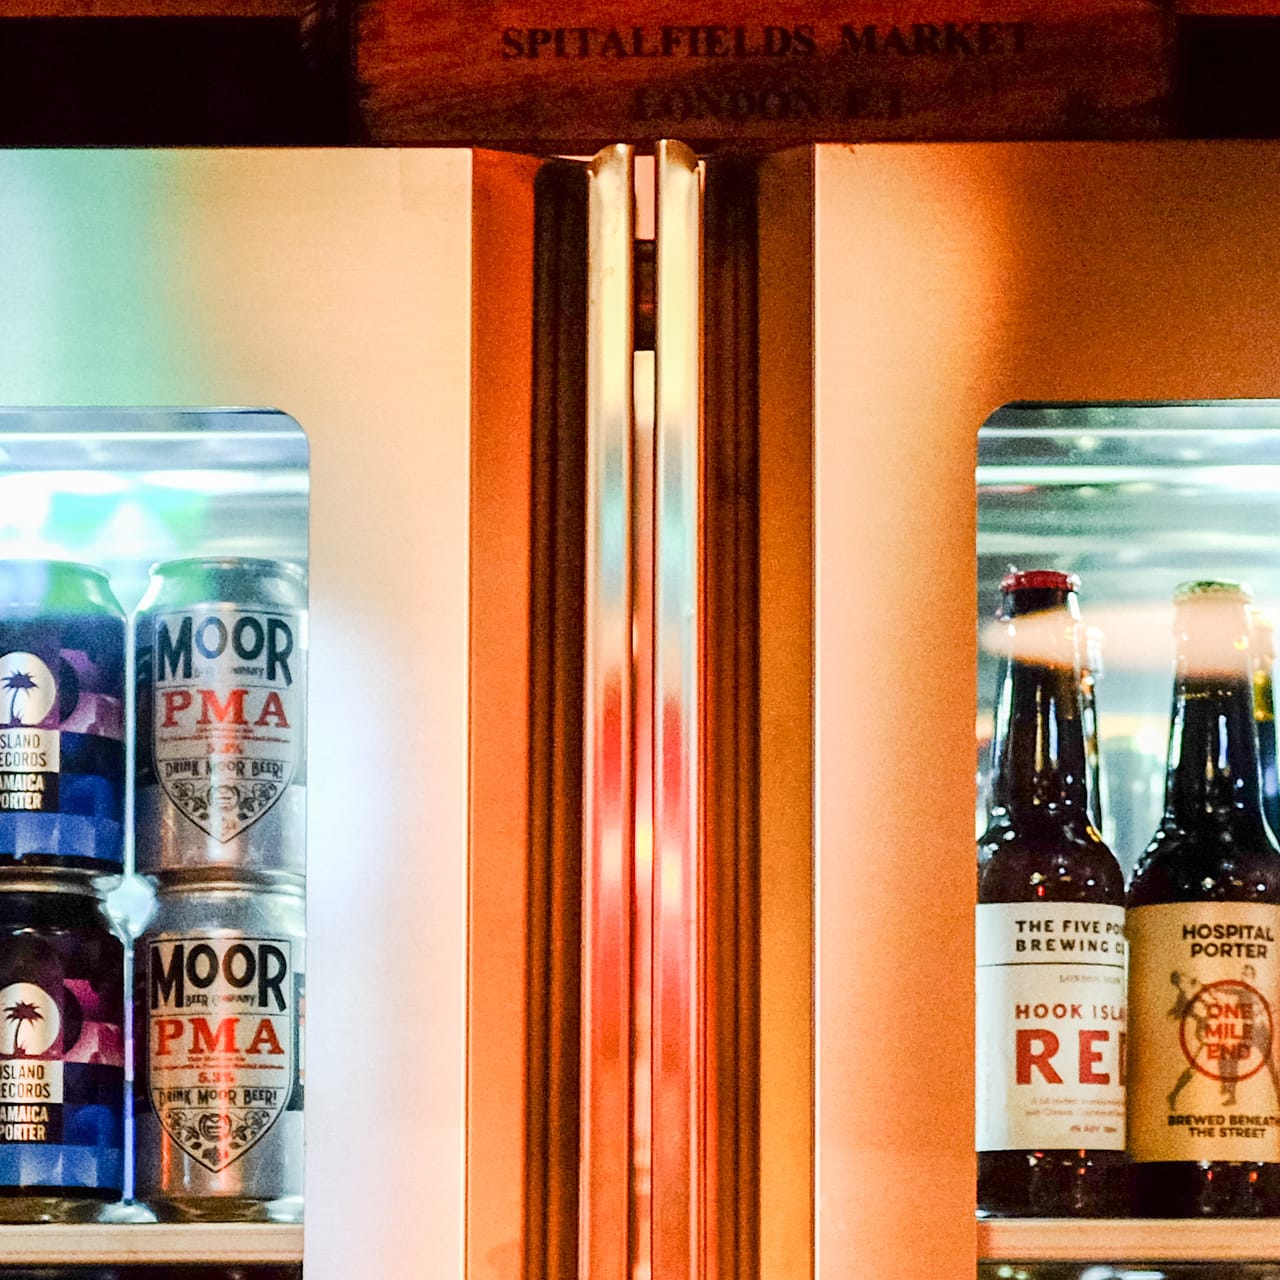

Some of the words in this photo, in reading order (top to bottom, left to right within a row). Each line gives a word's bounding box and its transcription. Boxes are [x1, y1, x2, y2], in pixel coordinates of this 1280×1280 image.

[501, 24, 816, 60] SPITALFIELDS
[840, 21, 1033, 56] MARKET
[634, 86, 819, 121] LONDON
[158, 616, 294, 686] MOOR
[162, 689, 290, 729] PMA
[165, 762, 201, 779] DRINK
[1015, 919, 1054, 933] THE
[1062, 920, 1100, 935] FIVE
[1181, 924, 1275, 942] HOSPITAL
[1016, 938, 1109, 954] BREWING
[1190, 942, 1269, 959] PORTER
[151, 943, 287, 1012] MOOR
[186, 993, 209, 1007] BEER
[1015, 1003, 1083, 1020] HOOK
[1207, 1003, 1253, 1020] ONE
[154, 1018, 285, 1056] PMA
[1205, 1023, 1254, 1041] MILE
[1207, 1043, 1251, 1061] END
[0, 1064, 45, 1080] ISLAND
[159, 1091, 191, 1107] DRINK
[197, 1089, 237, 1106] MOOR
[1167, 1114, 1225, 1127] BREWED
[1188, 1127, 1216, 1139] THE
[1220, 1127, 1267, 1140] STREET
